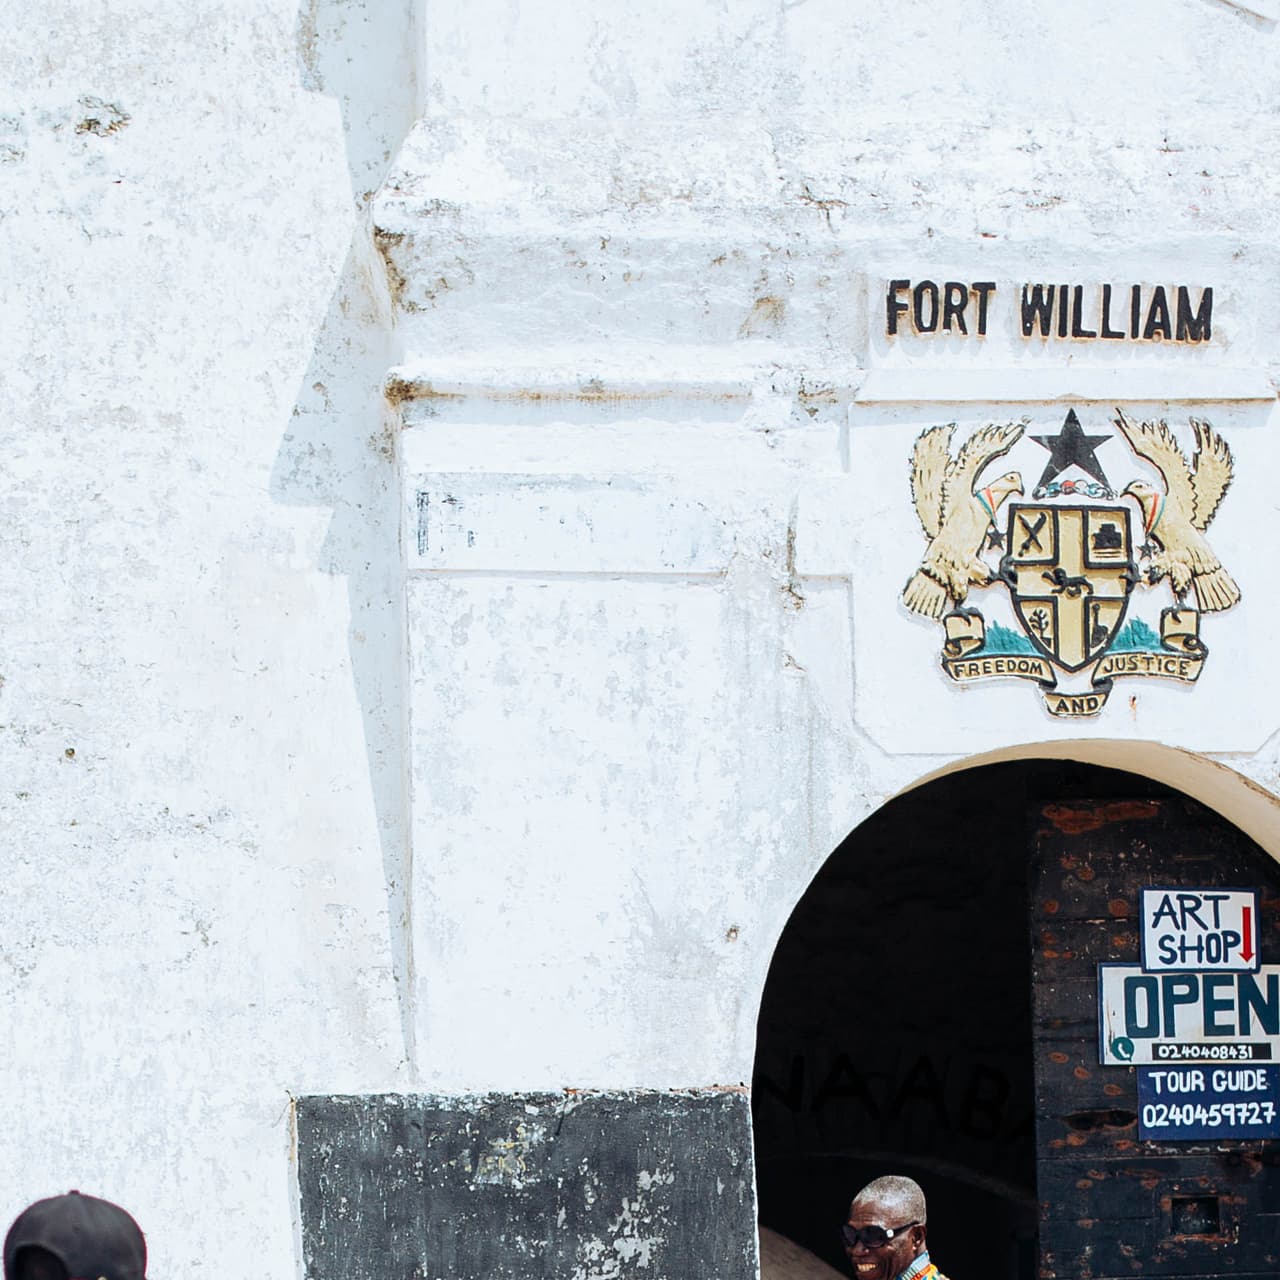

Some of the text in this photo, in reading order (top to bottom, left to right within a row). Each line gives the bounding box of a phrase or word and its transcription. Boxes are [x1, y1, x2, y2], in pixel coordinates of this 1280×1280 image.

[886, 279, 1213, 341] FORT WILLIAM
[954, 657, 1190, 677] FREEDOM JUSTICE
[1056, 697, 1099, 713] AND
[1152, 894, 1230, 931] ART
[1158, 930, 1241, 964] SHOP
[1124, 974, 1280, 1038] OPEN
[1158, 1045, 1253, 1059] 0240408431
[1148, 1069, 1268, 1094] TOUR GUIDE
[1142, 1101, 1276, 1128] 0240459727
